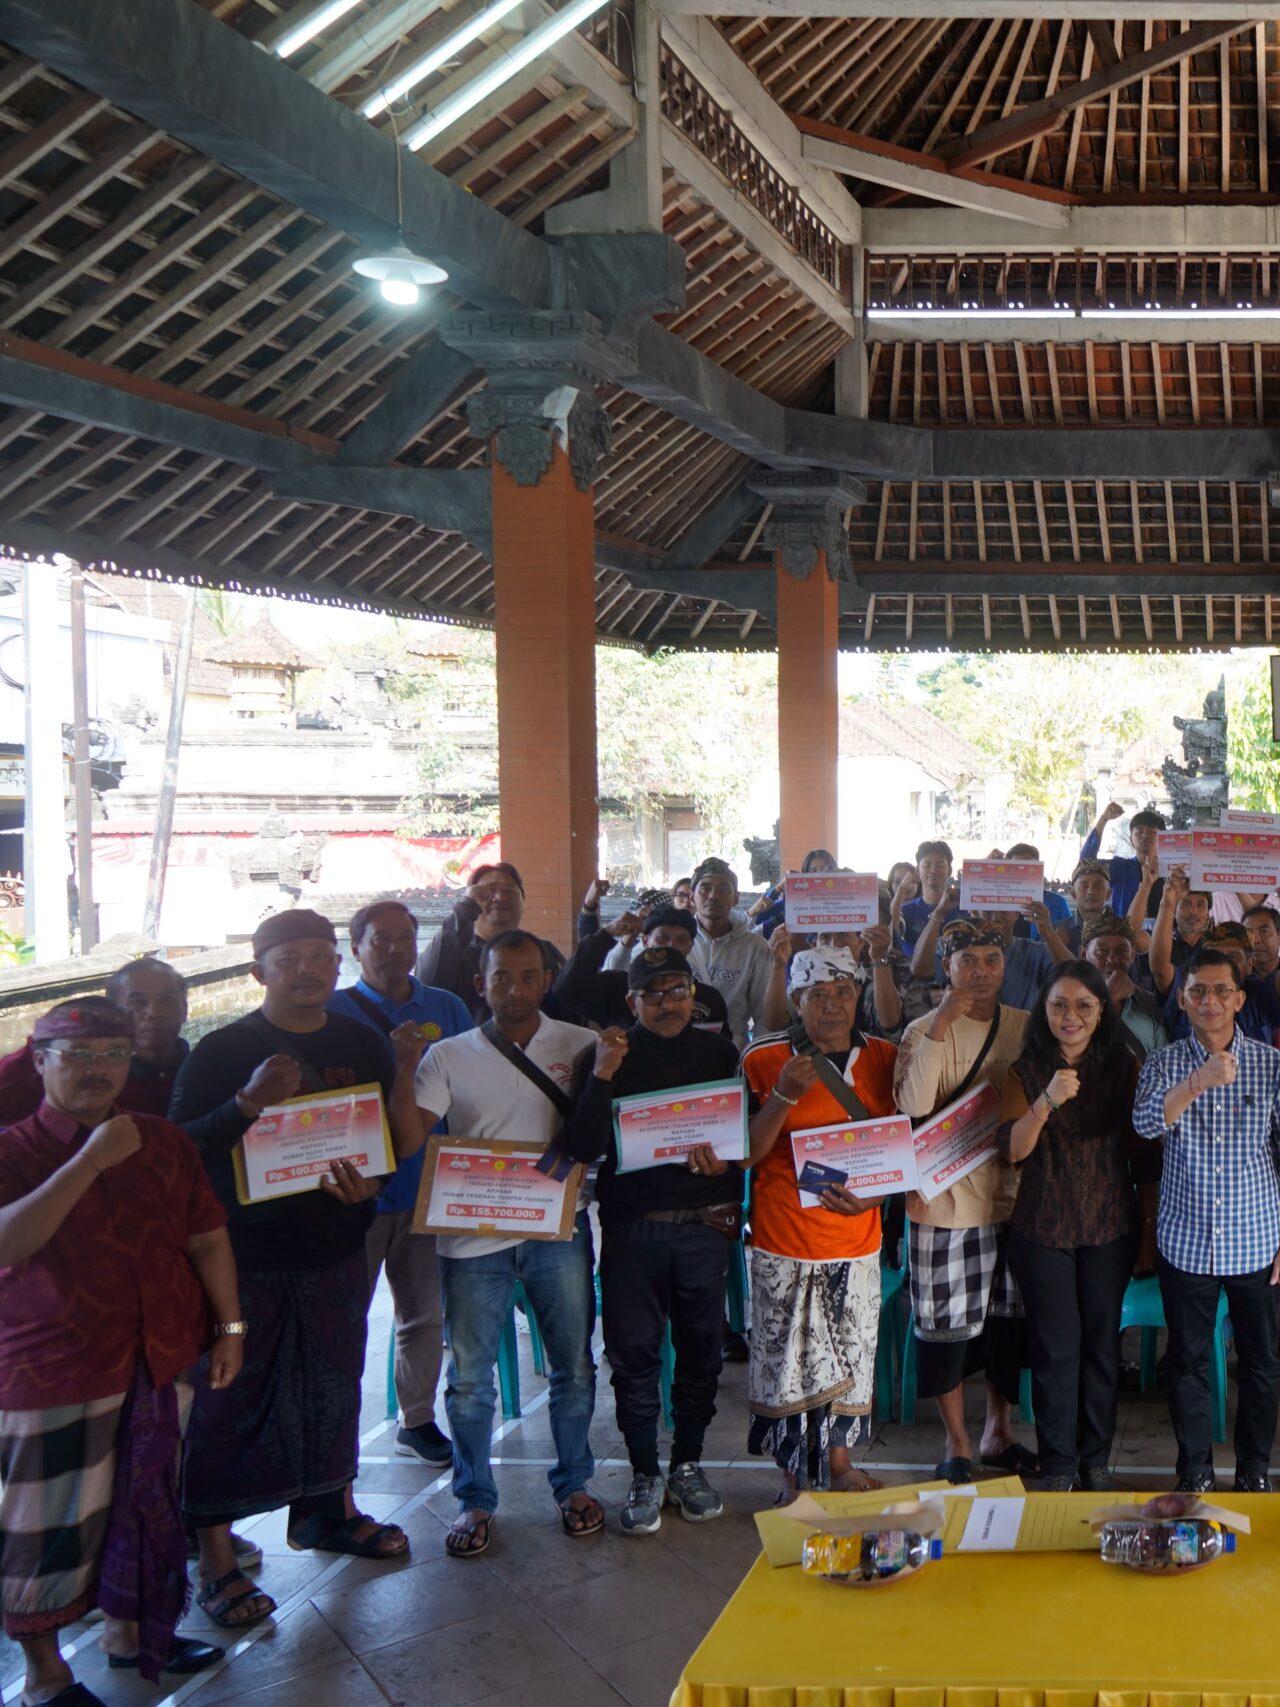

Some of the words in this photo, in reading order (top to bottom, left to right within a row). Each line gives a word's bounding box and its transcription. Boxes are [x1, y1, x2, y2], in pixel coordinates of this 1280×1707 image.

[269, 1171, 287, 1181] Rp.
[450, 1207, 467, 1216] Rp.
[471, 1208, 542, 1220] 155.700.000,-
